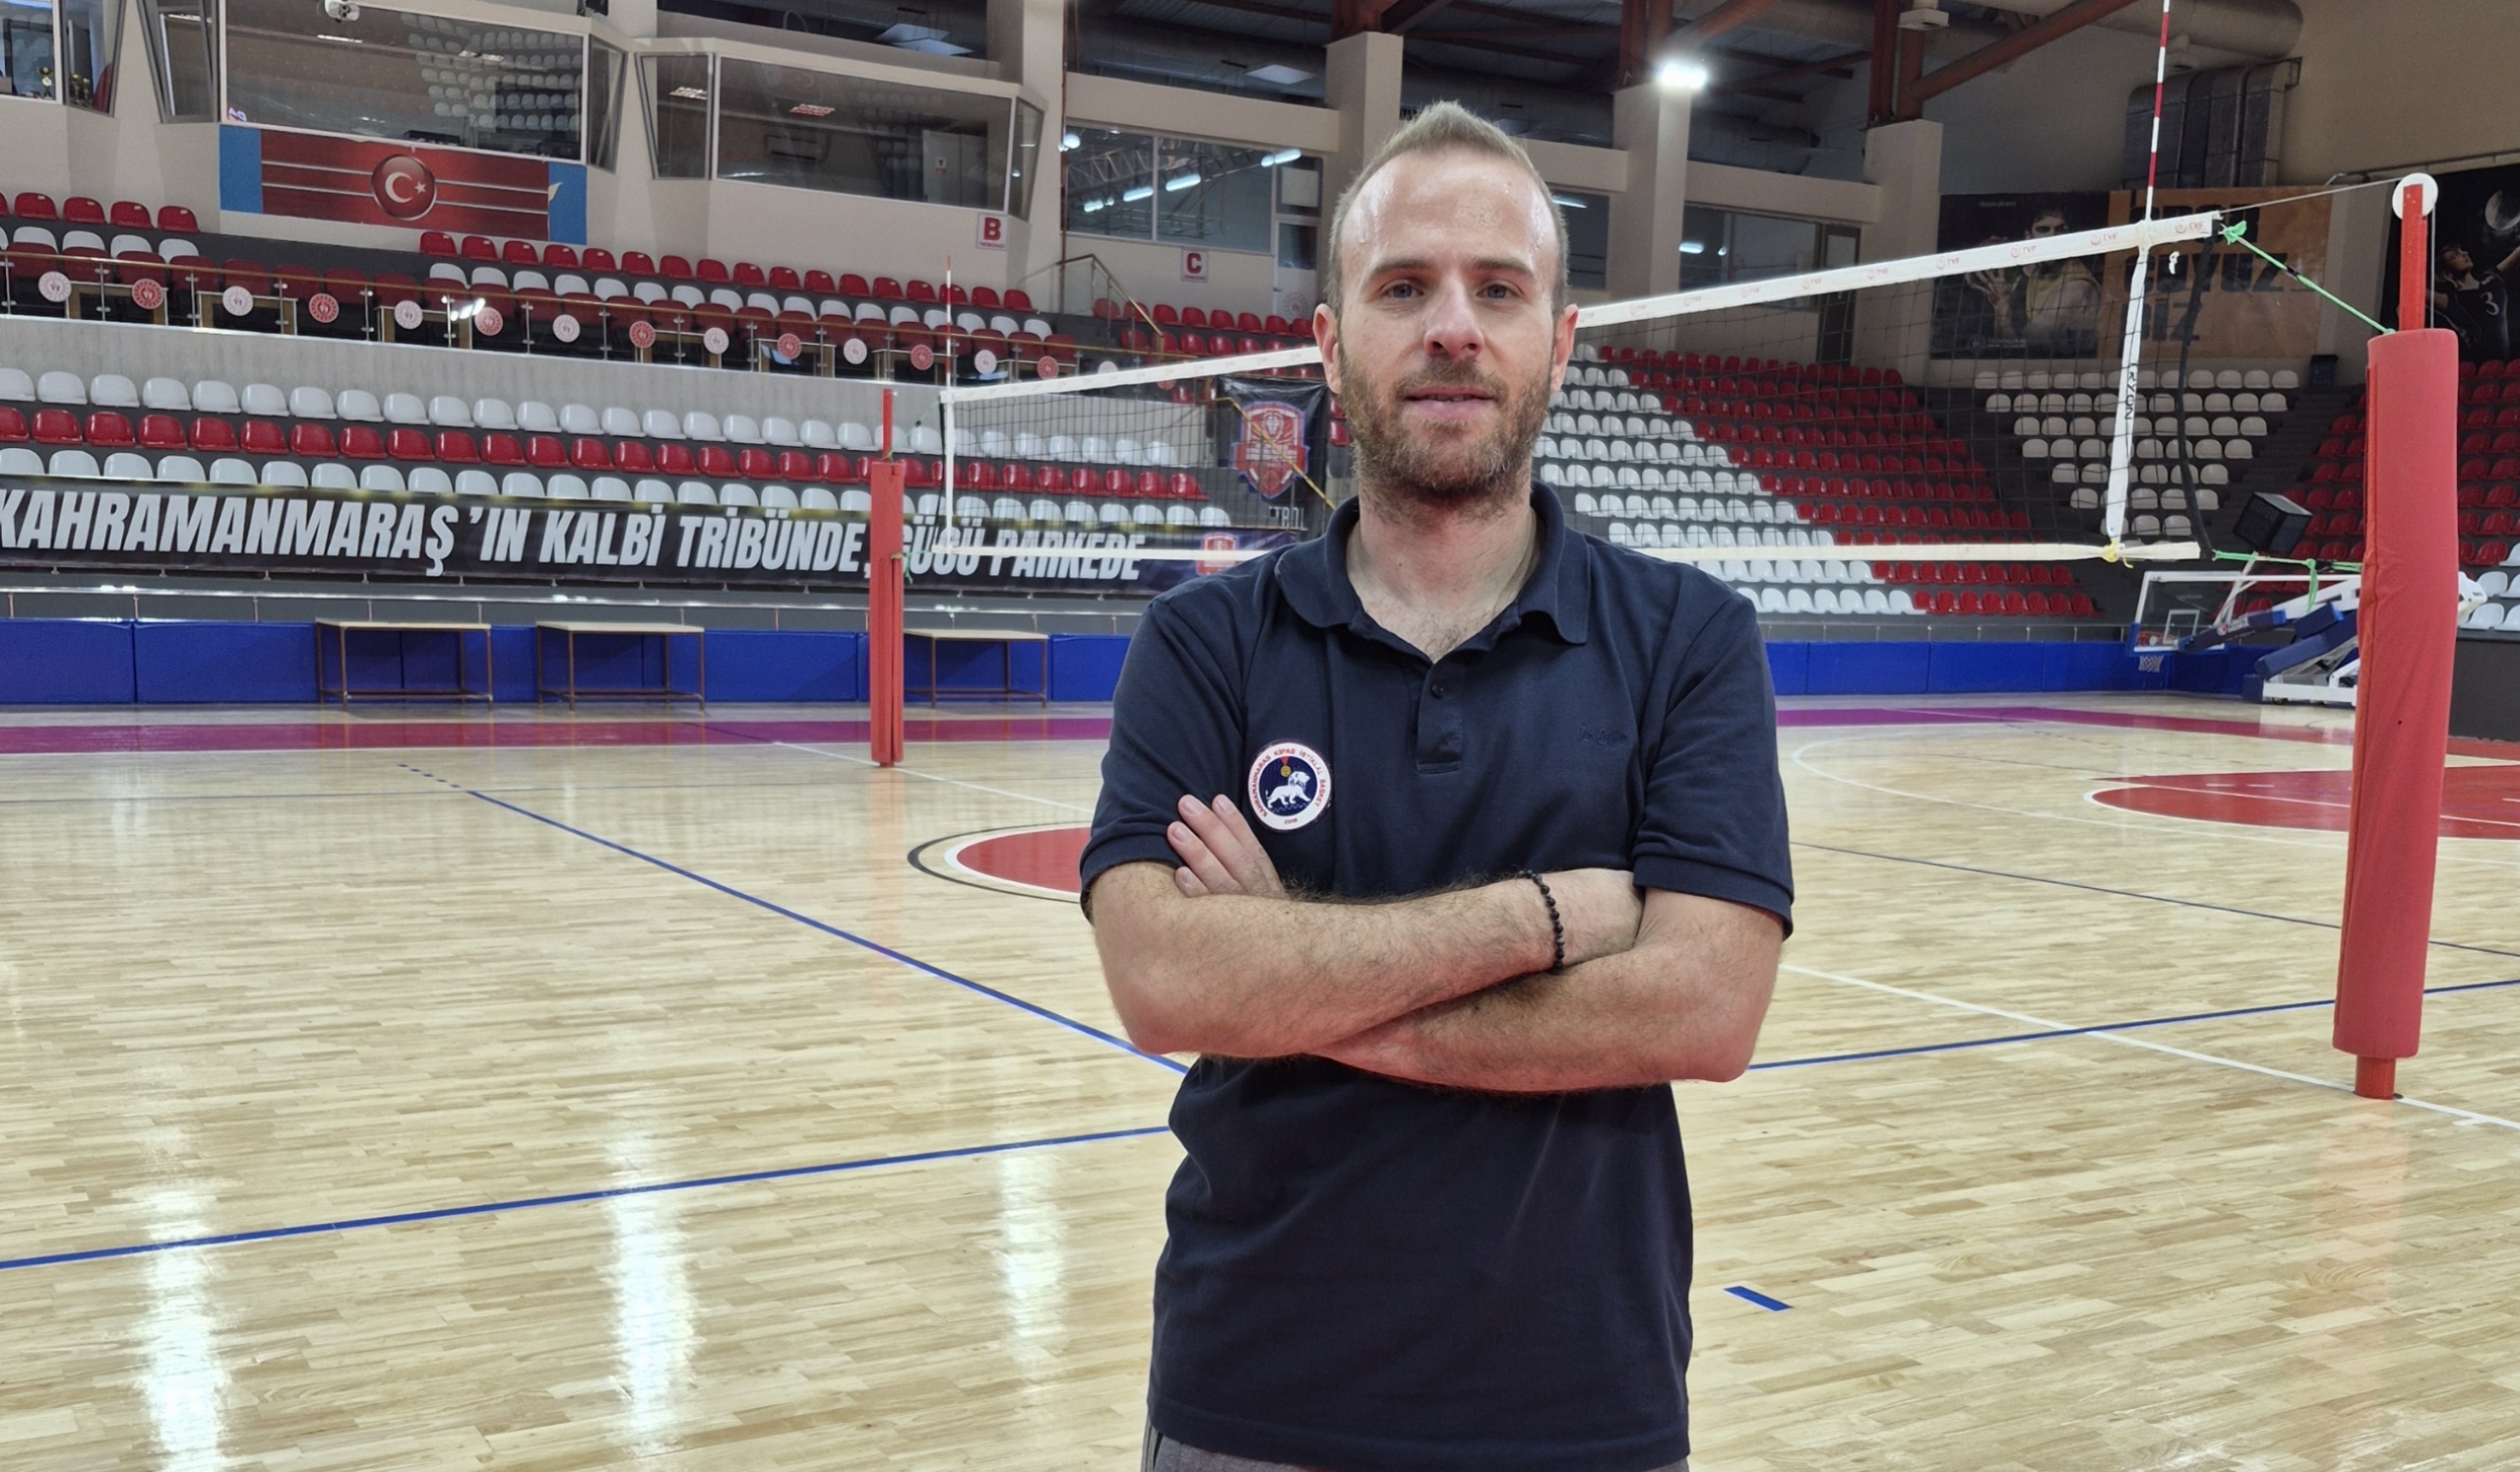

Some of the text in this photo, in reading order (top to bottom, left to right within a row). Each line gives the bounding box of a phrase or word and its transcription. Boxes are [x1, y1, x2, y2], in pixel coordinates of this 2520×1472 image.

[983, 217, 1001, 241] B
[1876, 267, 1889, 276] TVF
[1947, 257, 1960, 266] TVF
[2023, 245, 2037, 255] TVF
[2103, 232, 2117, 241] TVF
[2189, 222, 2204, 230] TVF
[1186, 252, 1202, 274] C
[2480, 291, 2499, 316] 3
[0, 488, 459, 578] KAHRAMANMARAŞ
[538, 503, 666, 566] KALBİ
[989, 528, 1147, 581] PARKEDE
